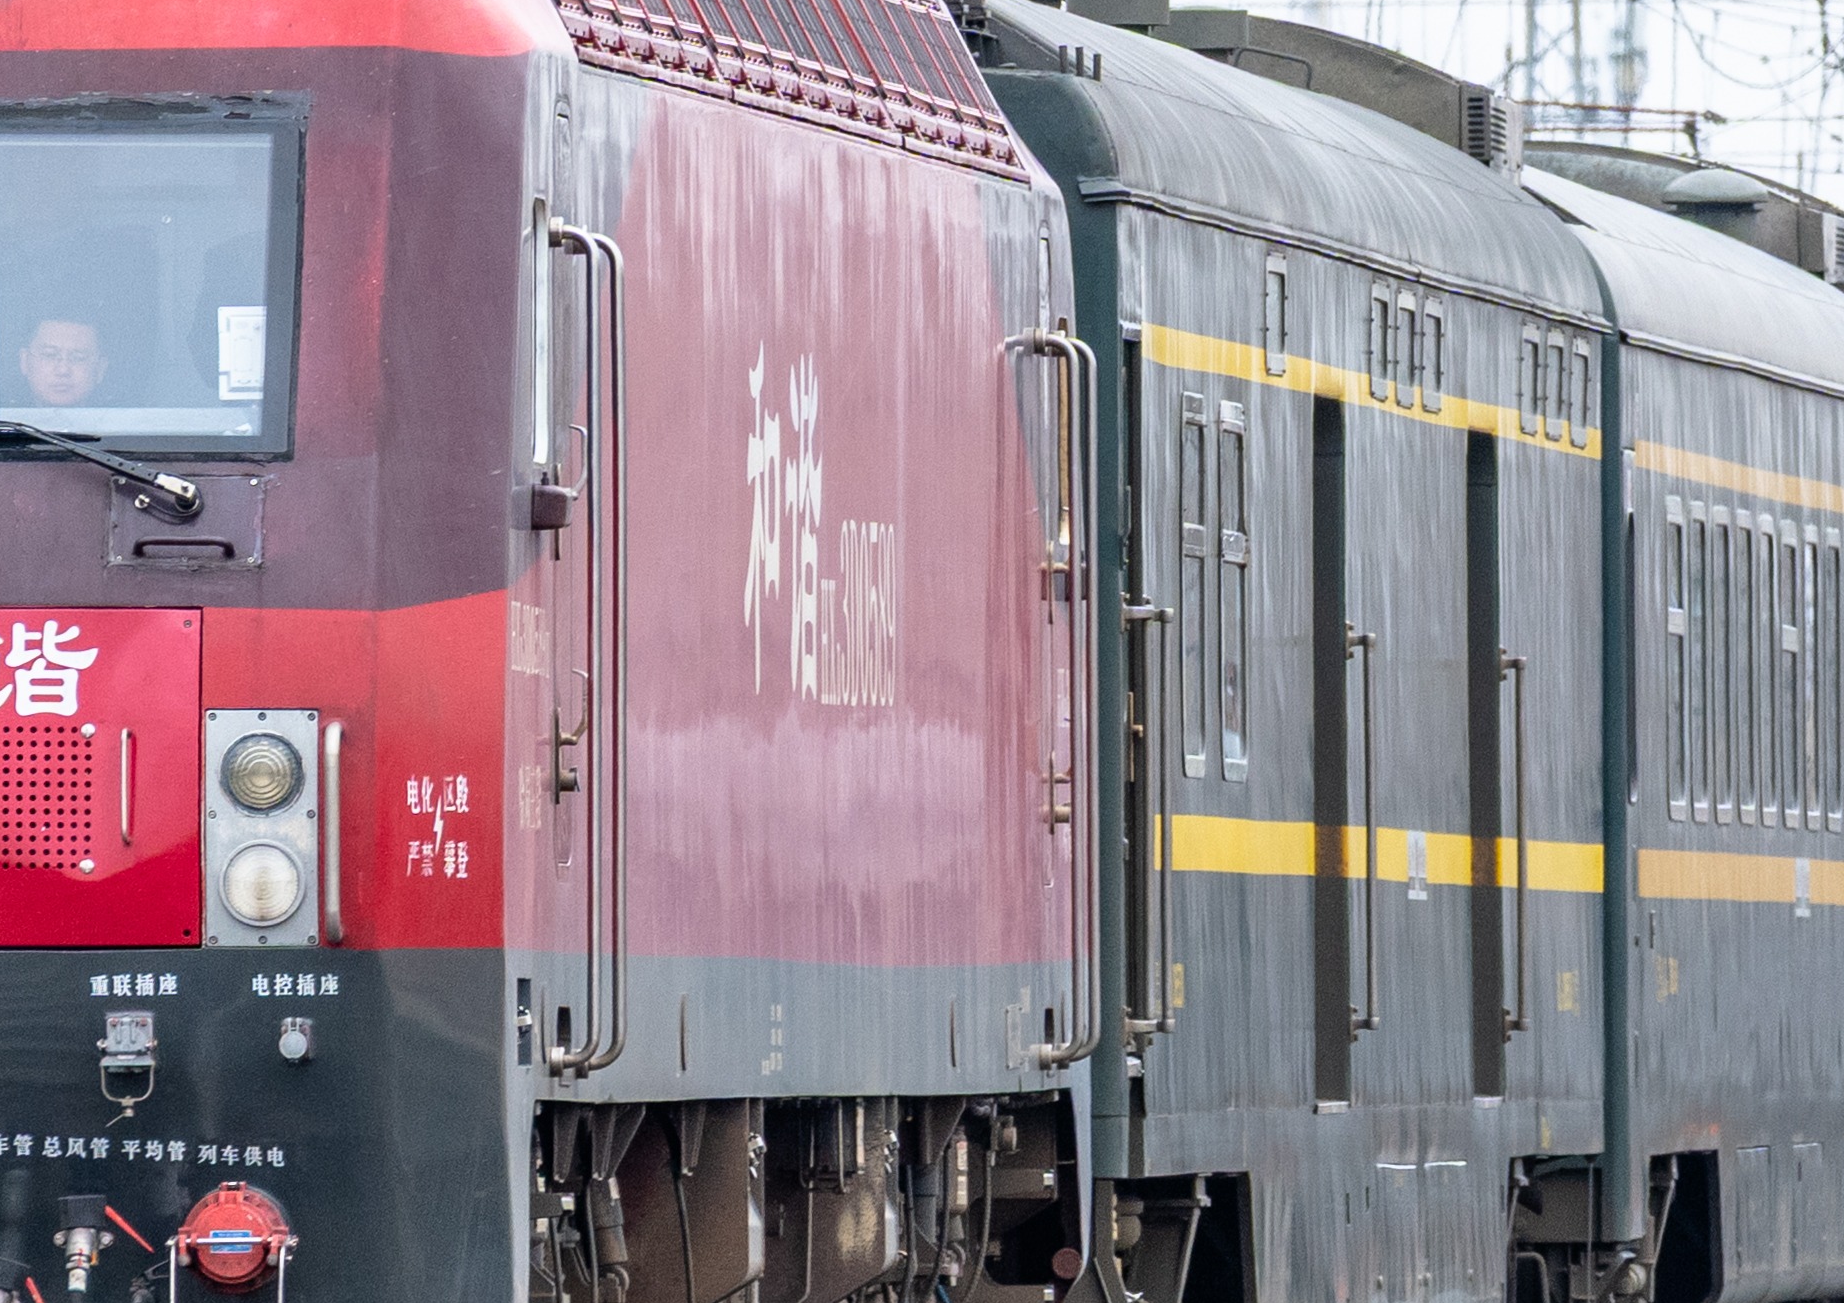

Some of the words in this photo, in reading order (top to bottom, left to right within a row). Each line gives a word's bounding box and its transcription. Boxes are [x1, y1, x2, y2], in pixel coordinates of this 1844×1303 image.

[744, 339, 823, 702] 和谐
[406, 773, 470, 814] 电化区段
[89, 973, 179, 997] 重联插座
[251, 974, 340, 997] 电控插座
[41, 1136, 110, 1160] 总风管
[120, 1140, 187, 1163] 平均管
[196, 1143, 286, 1168] 列车供电
